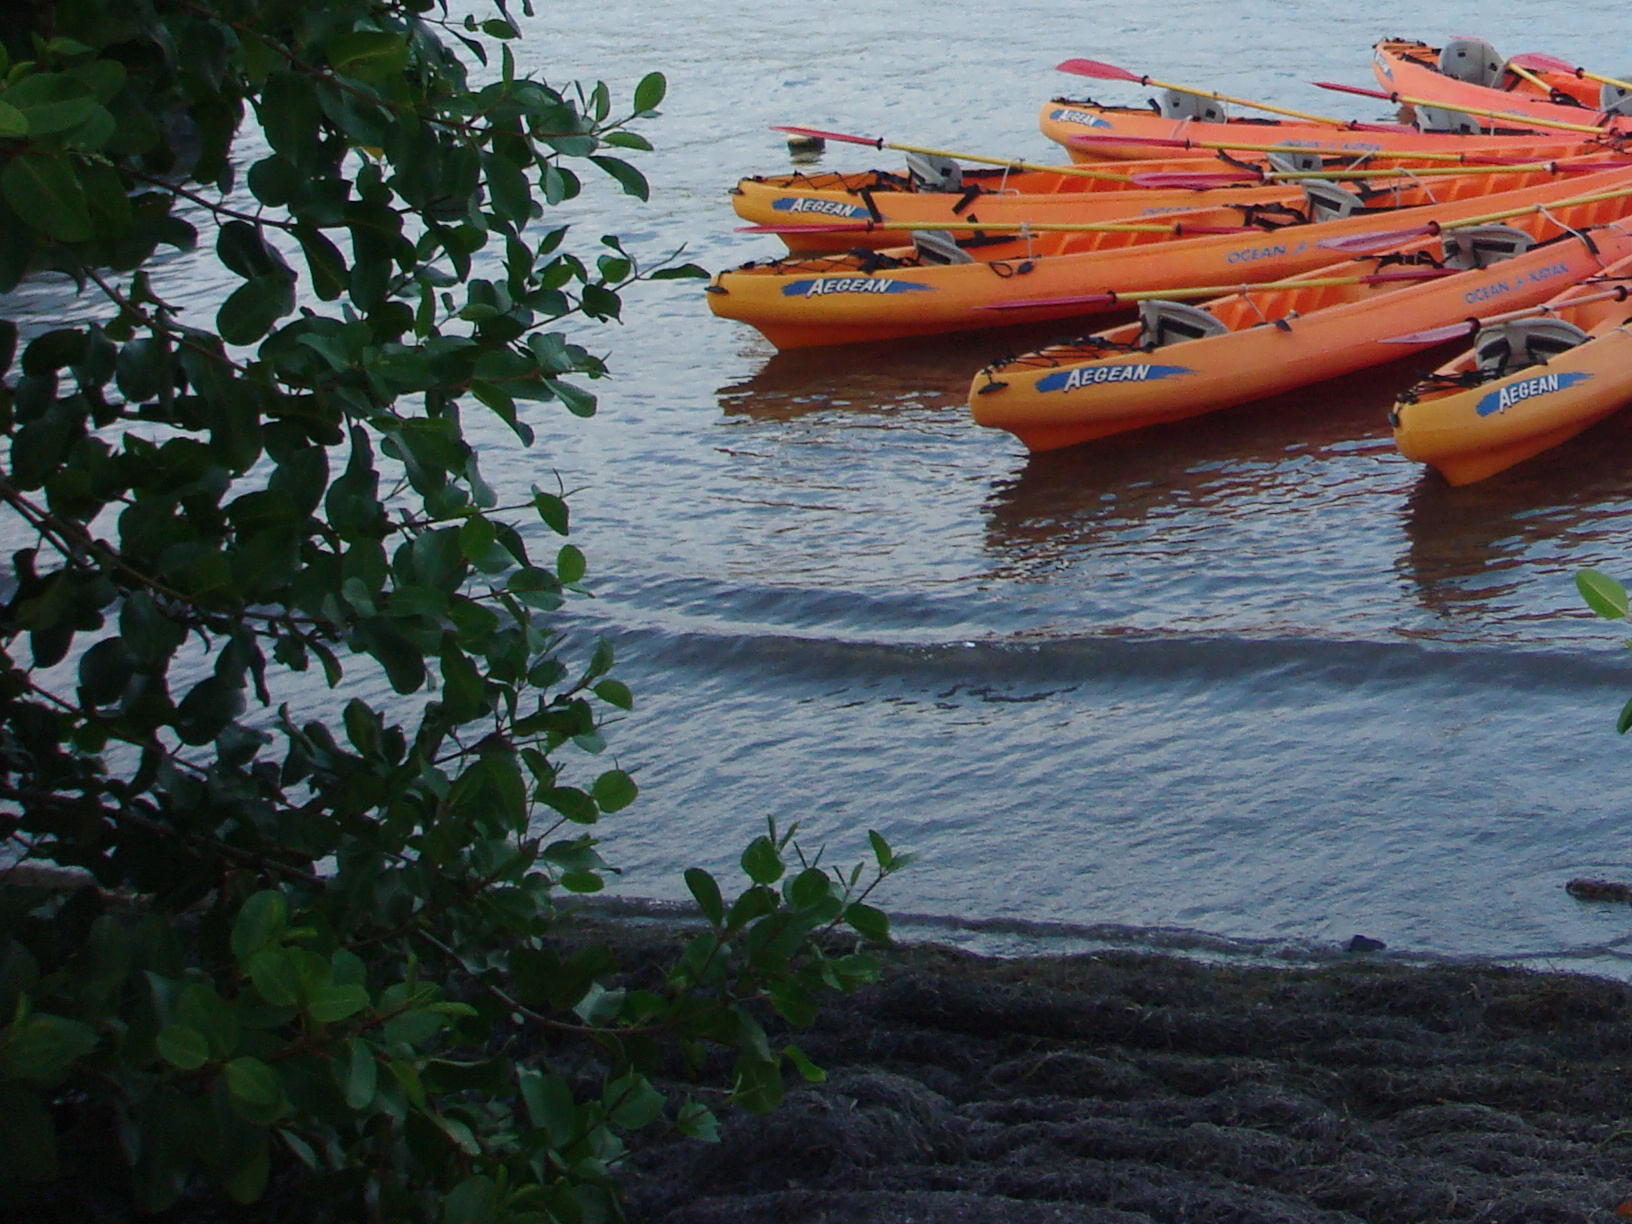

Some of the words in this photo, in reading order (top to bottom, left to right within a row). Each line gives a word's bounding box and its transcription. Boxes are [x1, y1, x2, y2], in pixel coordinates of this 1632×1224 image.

[1057, 109, 1096, 127] AEGEAN
[789, 196, 857, 218] AEGEAN
[1225, 244, 1286, 264] OCEAN
[806, 277, 894, 299] AEGEAN
[1463, 281, 1509, 304] OCEAN
[1062, 364, 1151, 393] AEGEAN
[1498, 373, 1560, 414] AEGEAN
